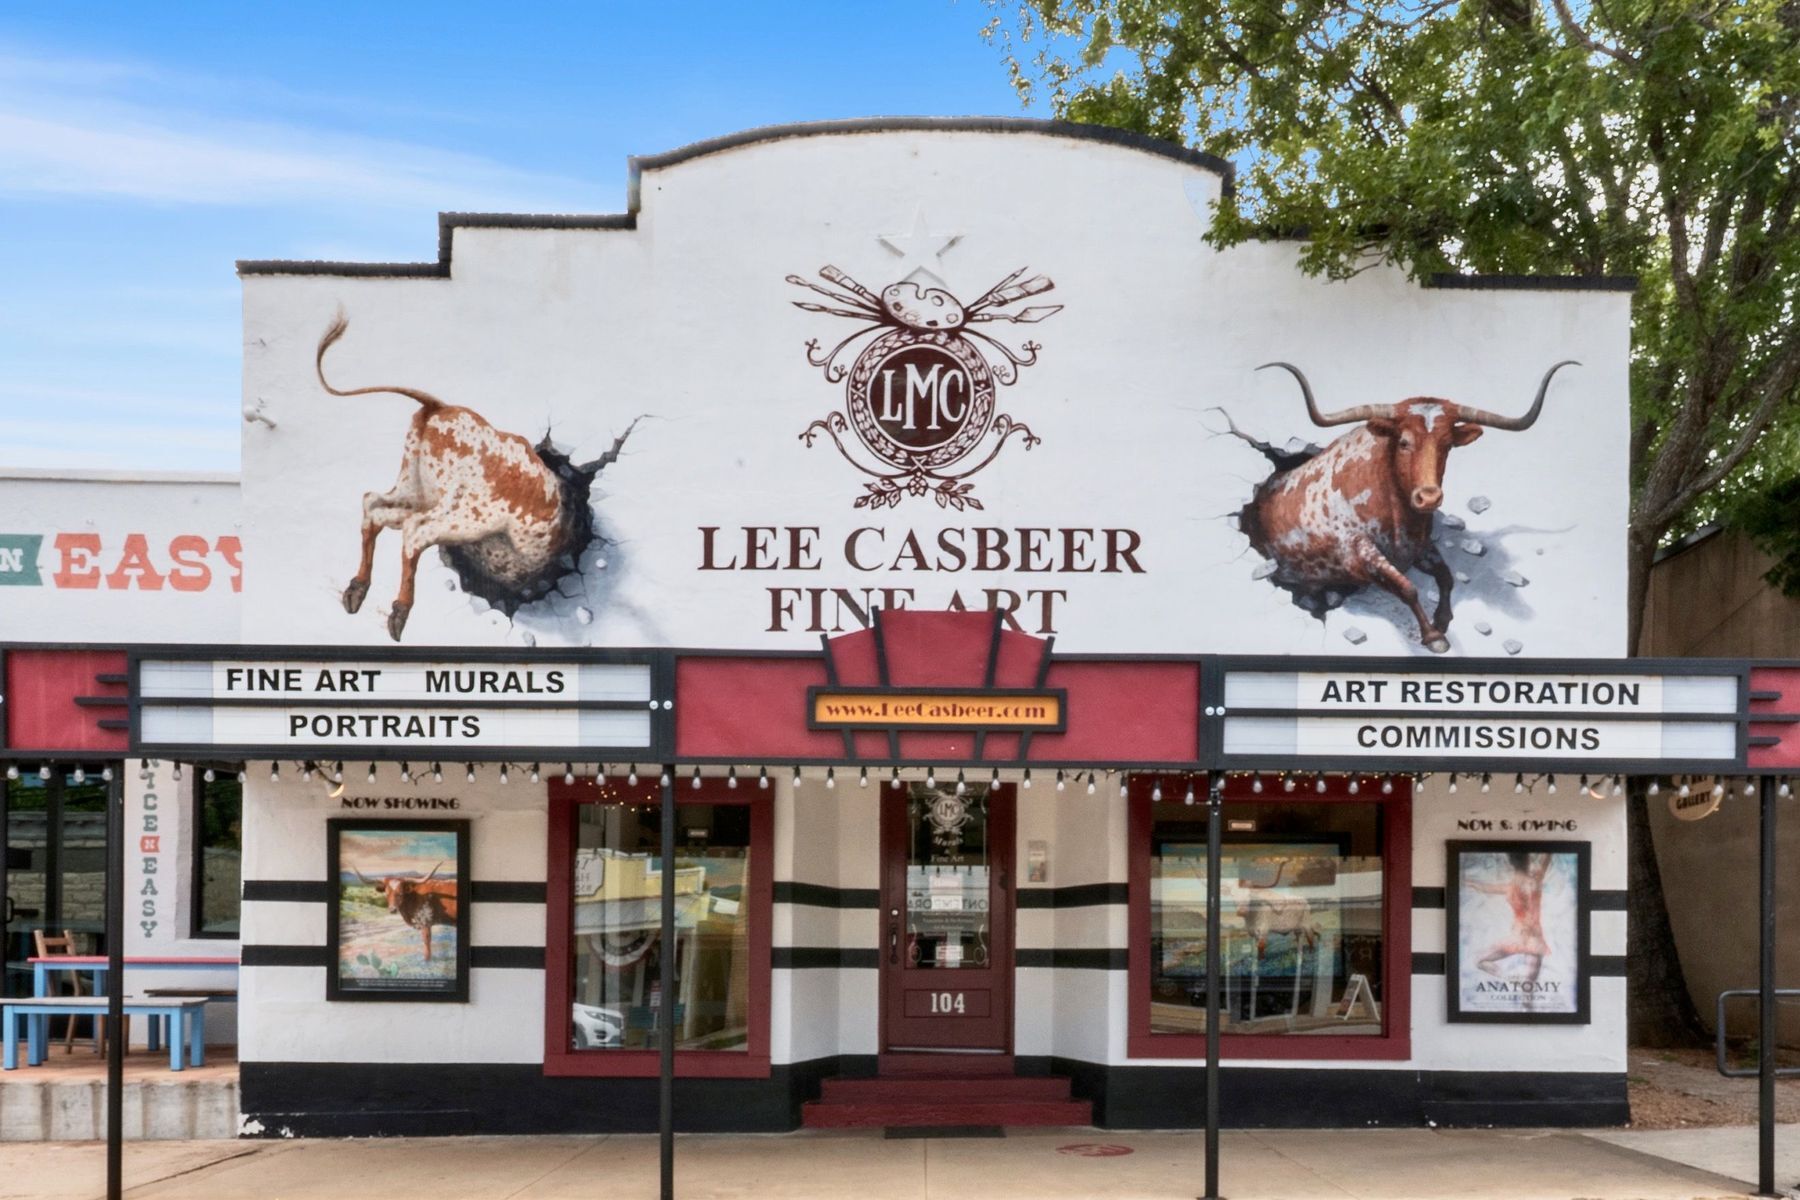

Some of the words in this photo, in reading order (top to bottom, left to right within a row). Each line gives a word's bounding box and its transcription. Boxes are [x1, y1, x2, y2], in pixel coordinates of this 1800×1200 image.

[879, 362, 967, 430] LMC
[697, 526, 823, 571] LEE
[844, 526, 1147, 574] CASBEER
[226, 668, 303, 692] FINE
[314, 669, 382, 693] ART
[425, 670, 566, 694] MURALS
[1320, 680, 1388, 703] ART
[1401, 681, 1641, 706] RESTORATION
[825, 702, 1046, 719] www.LeeCasbeer.com
[289, 714, 481, 739] PORTRAITS
[1357, 725, 1601, 751] COMMISSIONS
[142, 759, 160, 832] ICE
[341, 797, 380, 810] NOW
[384, 797, 461, 811] SHOWING
[1500, 819, 1578, 832] SOWING
[140, 857, 159, 938] EASY
[1475, 980, 1562, 993] ANATOMY
[931, 992, 965, 1014] 104
